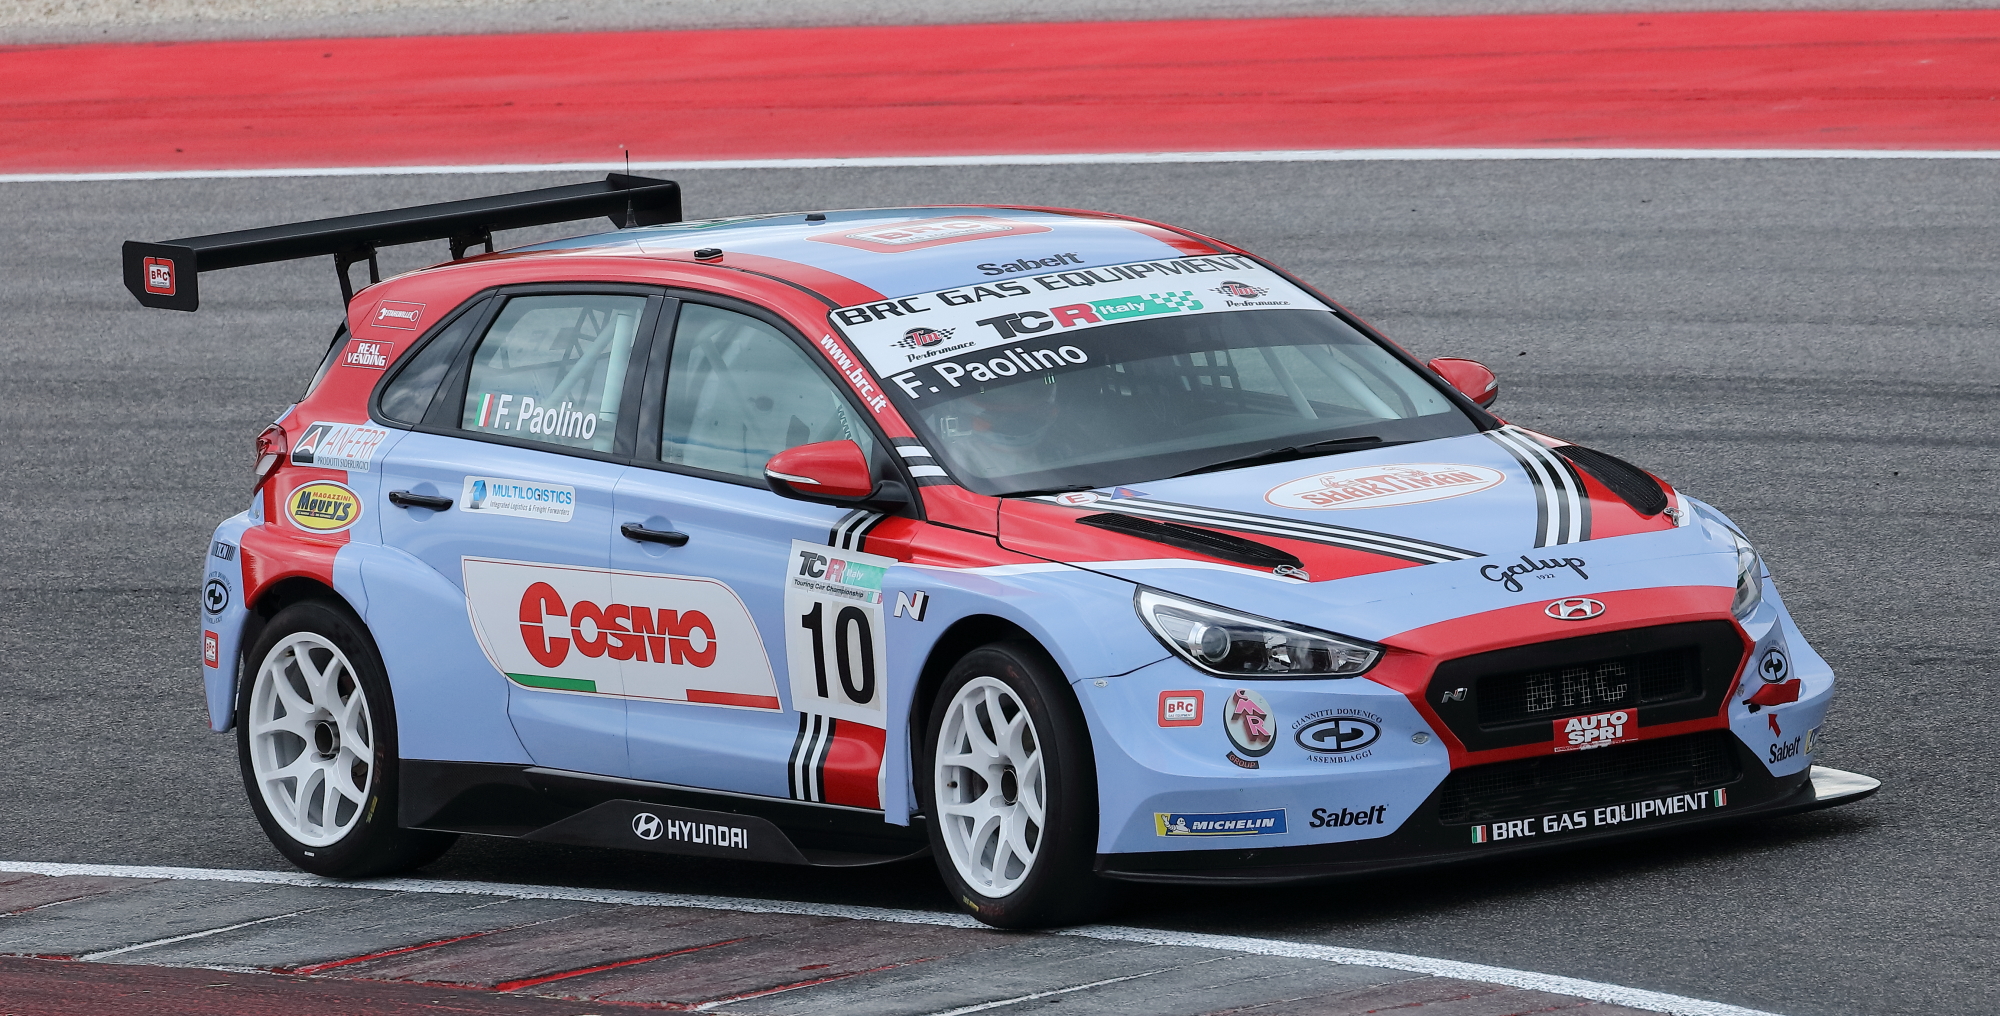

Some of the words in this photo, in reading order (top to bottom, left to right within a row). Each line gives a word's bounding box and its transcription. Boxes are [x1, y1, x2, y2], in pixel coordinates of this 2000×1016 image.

[872, 223, 981, 239] BRC
[151, 269, 168, 281] BRC
[976, 252, 1084, 276] Sabelt
[834, 297, 931, 326] BRC
[936, 280, 1032, 306] GAS
[1033, 255, 1256, 291] EQUIPMENT
[1224, 299, 1291, 308] Performance
[976, 302, 1102, 339] TCR
[1100, 301, 1146, 315] Italy
[347, 352, 387, 366] VENDING
[357, 343, 380, 355] REAL
[905, 340, 976, 363] Performance
[820, 333, 887, 413] www.brc.it
[890, 371, 940, 399] F.
[932, 345, 1088, 388] Paolino
[494, 394, 510, 429] F.
[516, 396, 597, 440] Paolino
[319, 426, 387, 459] ANFERR
[318, 456, 339, 468] PRODOTTI
[312, 491, 351, 501] MAGAZZINI
[492, 484, 572, 505] MULTILOGISTICS
[1301, 472, 1484, 505] SHAKTIMAN
[490, 501, 510, 509] Integrated
[510, 502, 528, 511] Logistics
[532, 505, 547, 514] Freight
[547, 507, 570, 516] Forwarders
[799, 551, 846, 583] TCR
[846, 569, 864, 580] Italy
[1480, 554, 1589, 592] Galup
[794, 579, 814, 589] Touring
[826, 585, 864, 598] Championship
[519, 581, 717, 668] COSMO
[802, 601, 875, 704] 10
[1526, 662, 1627, 713] BRC
[1168, 701, 1193, 713] BRC
[1233, 688, 1271, 742] CMR
[1291, 708, 1333, 730] GIANNITTI
[1337, 708, 1383, 724] DOMENICO
[1564, 711, 1628, 733] AUTO
[1229, 754, 1256, 769] GROUP
[1307, 749, 1373, 764] ASSEMBLAGGI
[1769, 736, 1801, 764] Sabelt
[1192, 818, 1275, 831] MICHELIN
[1309, 805, 1387, 828] Sabelt
[1492, 818, 1535, 841] BRC
[1543, 811, 1586, 833] GAS
[1594, 791, 1709, 826] EQUIPMENT
[667, 819, 748, 849] HYUNDAI
